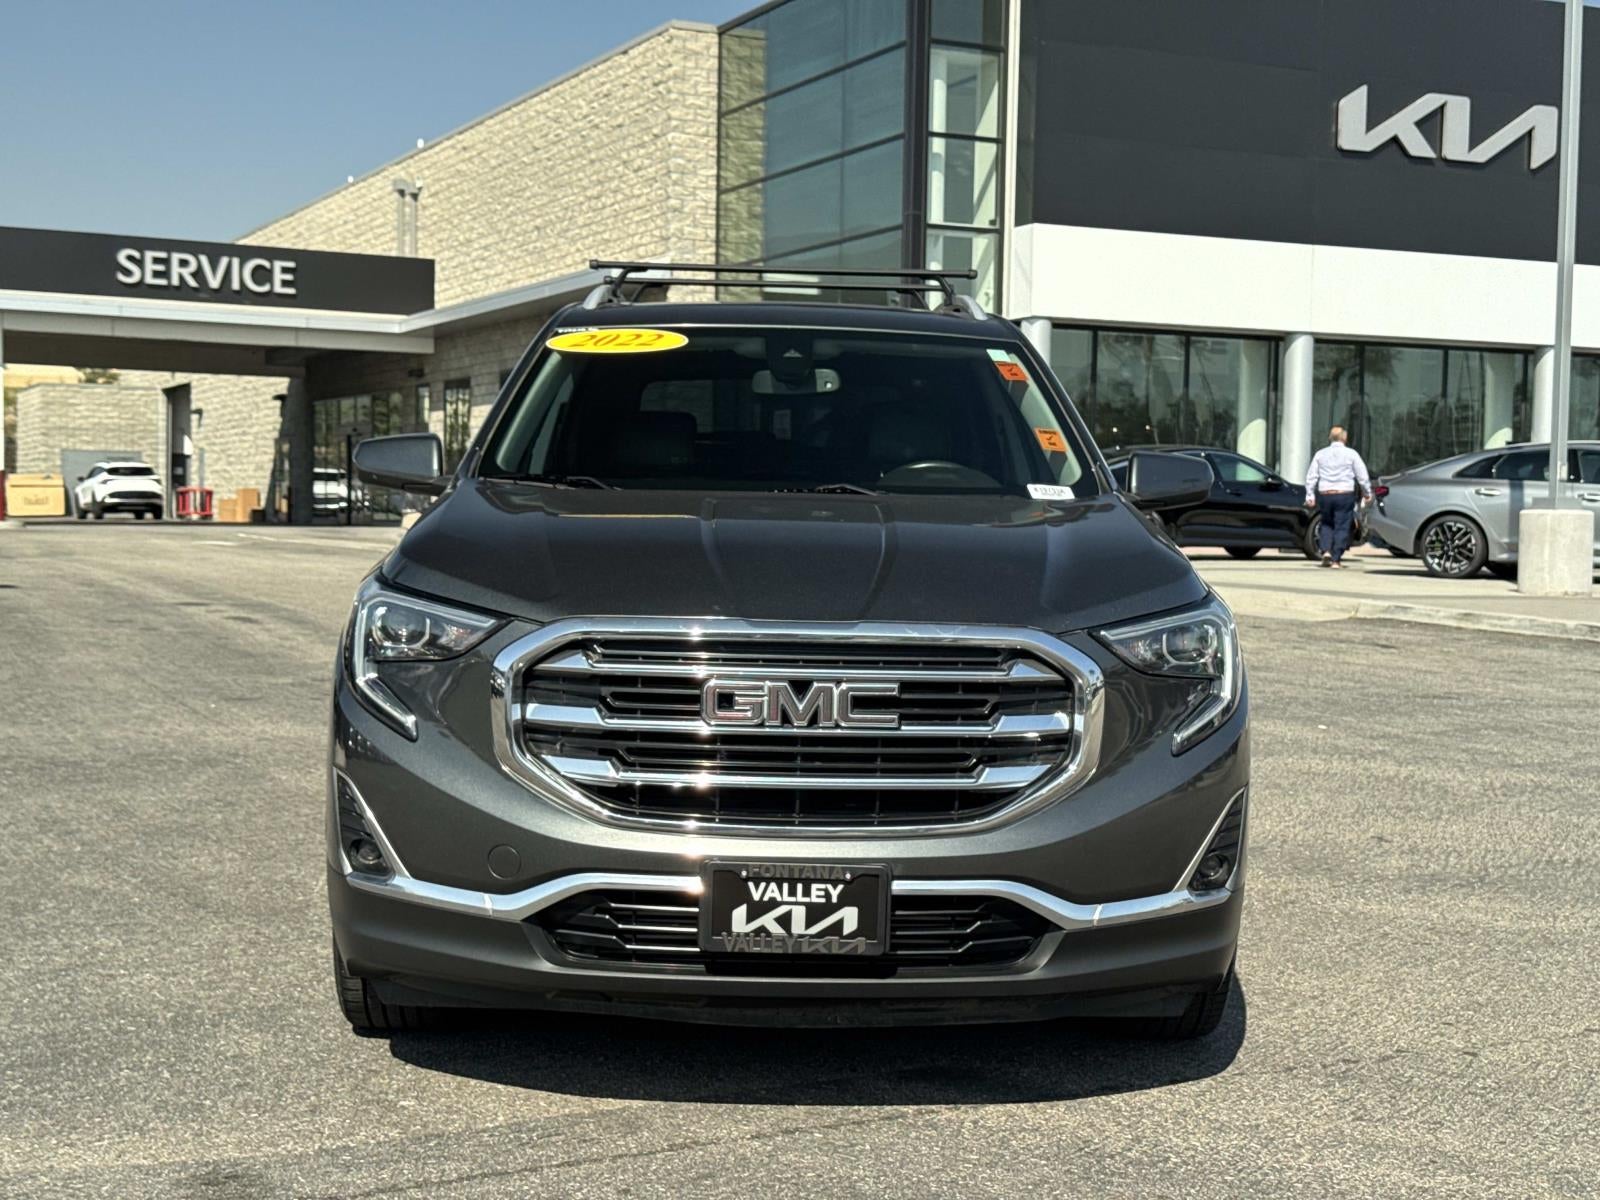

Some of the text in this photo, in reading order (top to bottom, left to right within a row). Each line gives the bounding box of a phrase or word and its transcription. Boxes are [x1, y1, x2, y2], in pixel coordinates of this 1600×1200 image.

[1338, 84, 1558, 170] KIA
[116, 248, 297, 295] SERVICE
[568, 333, 665, 348] 2022
[703, 679, 900, 727] GMC
[750, 864, 845, 879] FONTANA
[748, 882, 844, 903] VALLEY
[732, 903, 858, 936] KIA
[721, 932, 800, 953] VALLEY
